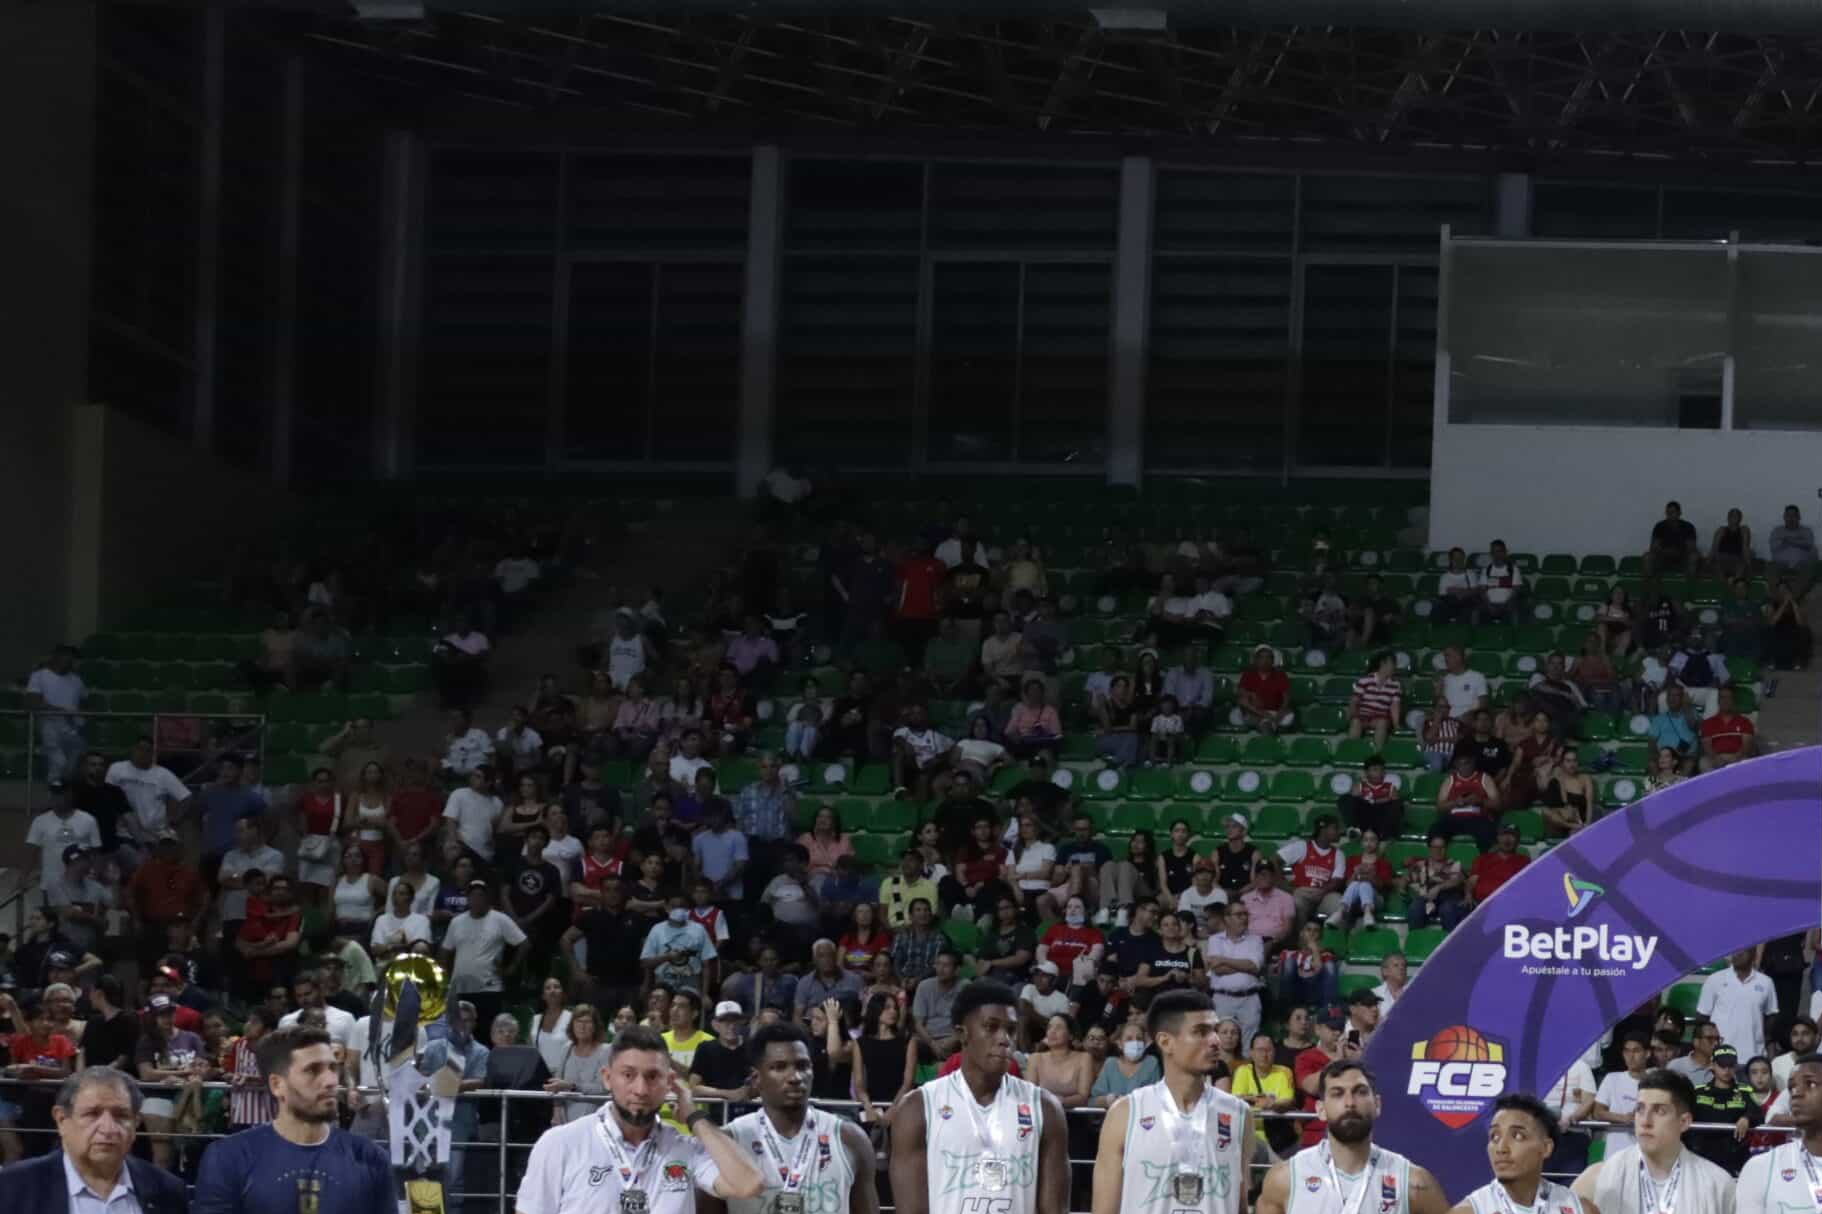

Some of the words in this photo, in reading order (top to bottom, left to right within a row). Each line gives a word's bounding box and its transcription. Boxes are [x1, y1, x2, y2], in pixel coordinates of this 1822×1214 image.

[1503, 924, 1658, 970] BetPlay
[1154, 958, 1189, 969] adidas
[1521, 965, 1569, 976] Apuéstale
[1572, 967, 1578, 975] a
[1581, 967, 1591, 976] tu
[1594, 967, 1626, 977] pasión
[1407, 1062, 1507, 1097] FCB
